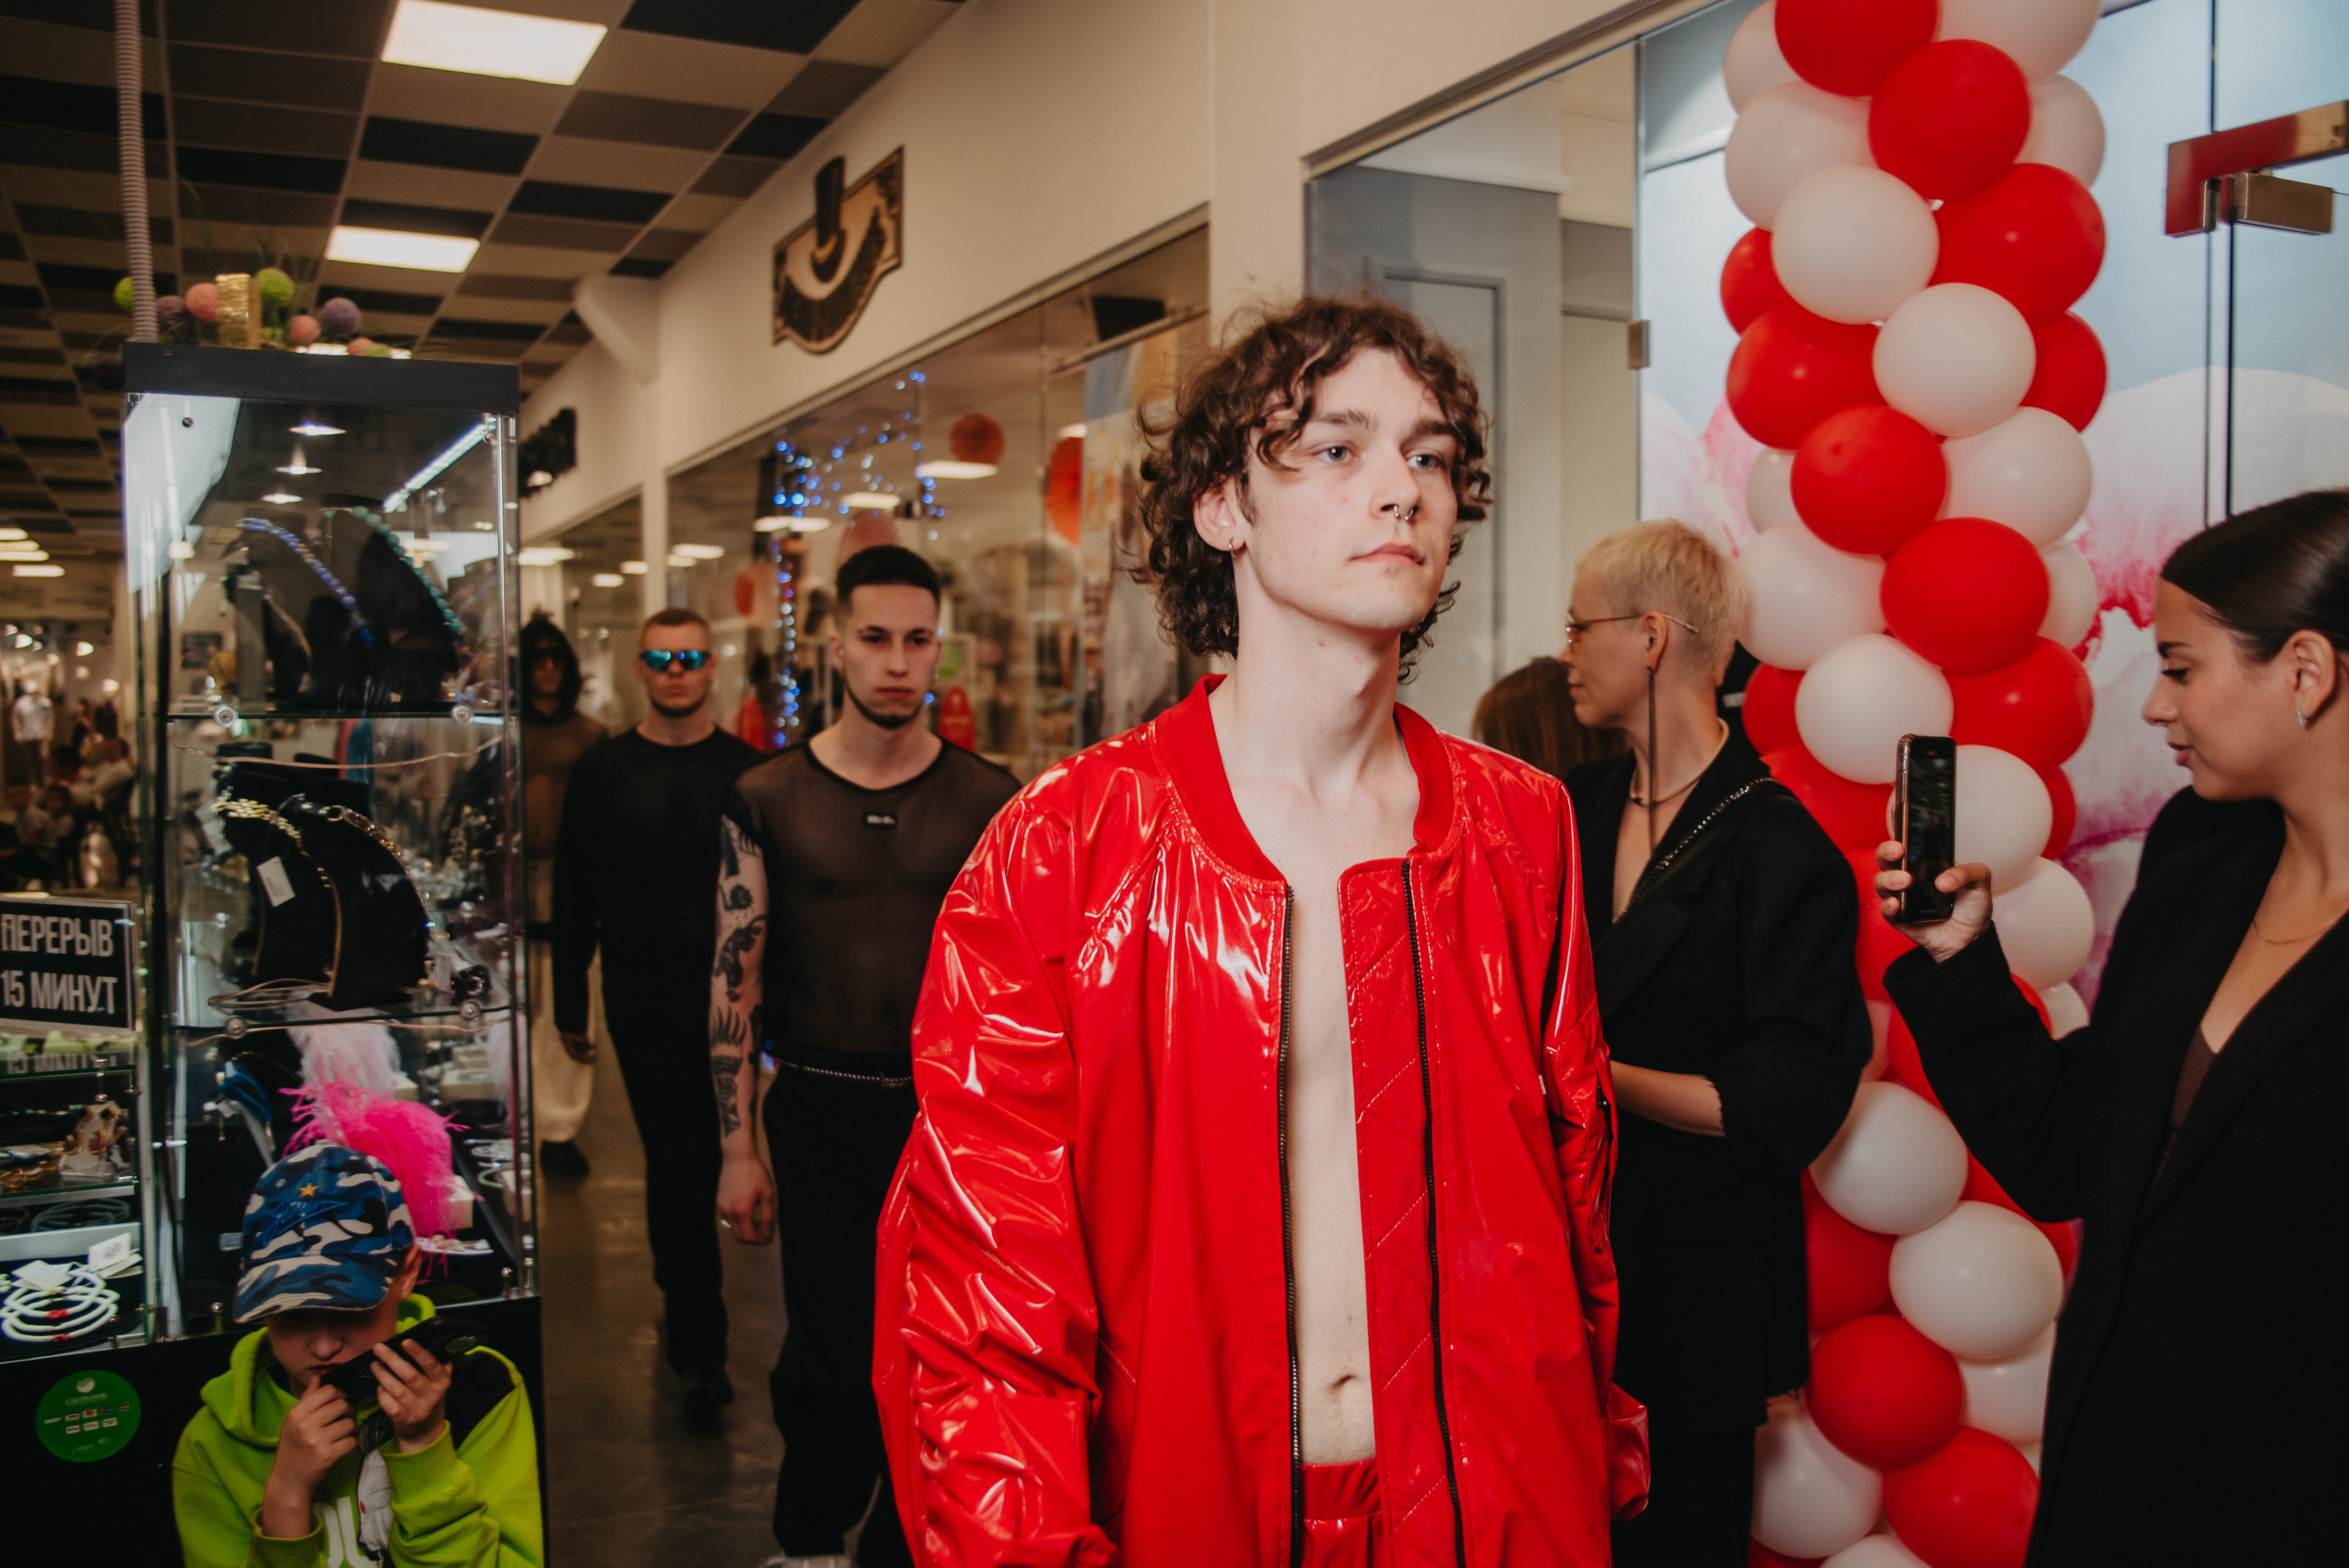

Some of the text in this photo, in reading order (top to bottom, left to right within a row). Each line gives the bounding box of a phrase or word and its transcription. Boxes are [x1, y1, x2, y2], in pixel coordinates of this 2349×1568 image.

[1, 913, 115, 958] ПЕРЕРЫВ
[0, 969, 118, 1015] 15 МИНУТ
